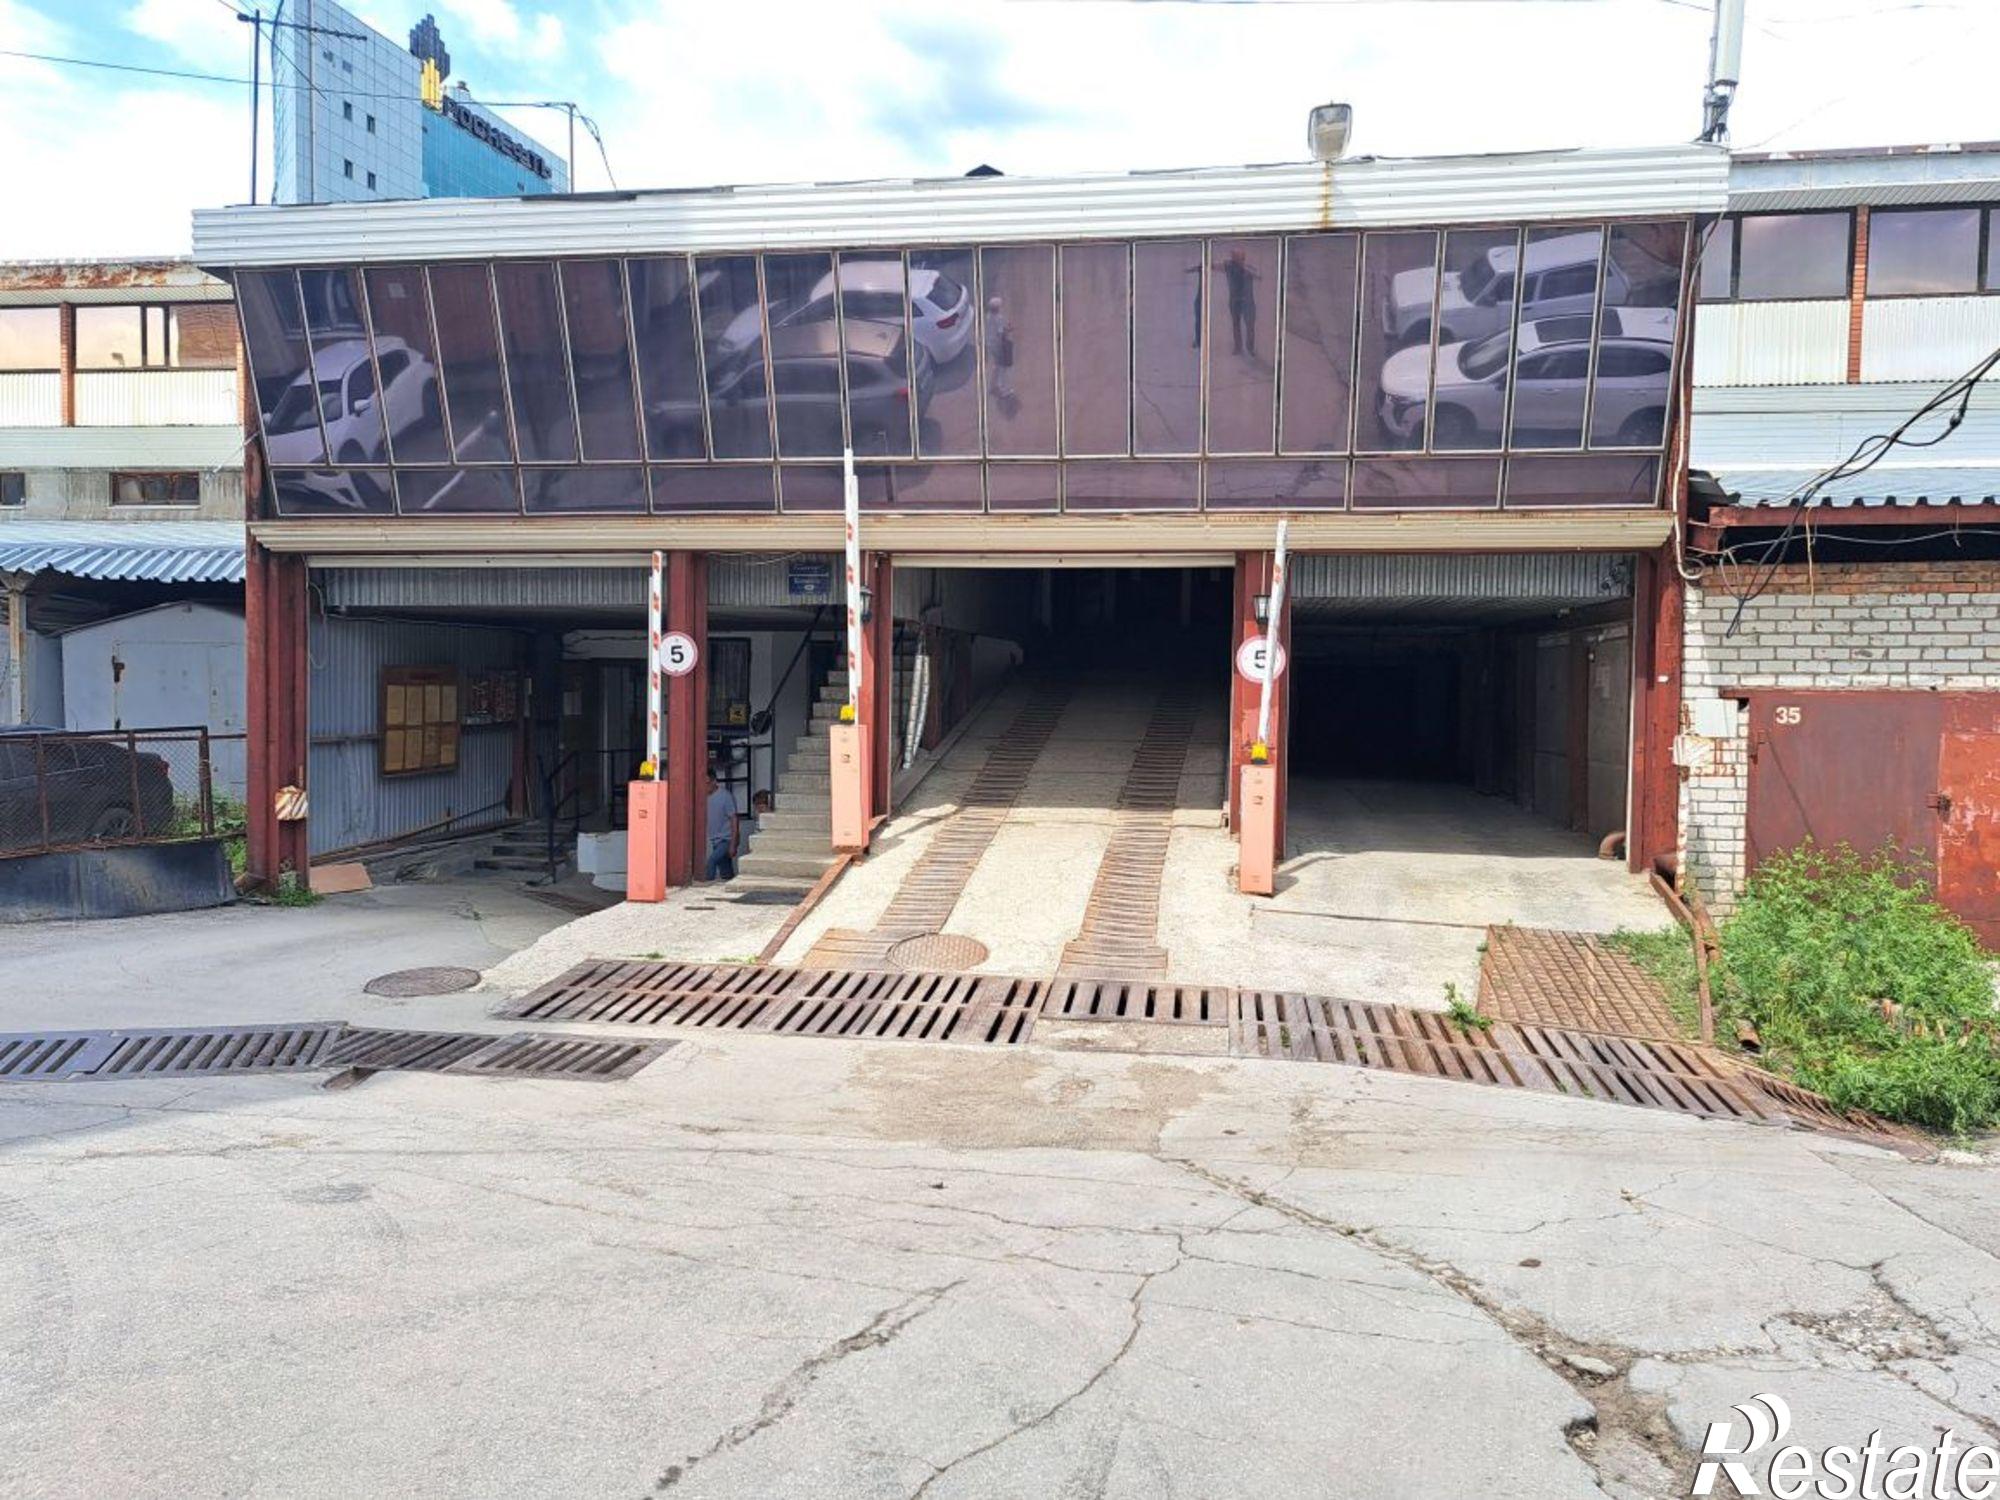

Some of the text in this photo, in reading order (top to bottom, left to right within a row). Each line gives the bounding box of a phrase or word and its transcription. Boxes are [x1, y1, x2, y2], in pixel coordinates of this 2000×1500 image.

[670, 645, 685, 664] 5
[1254, 650, 1267, 669] 5
[1775, 706, 1801, 725] 35
